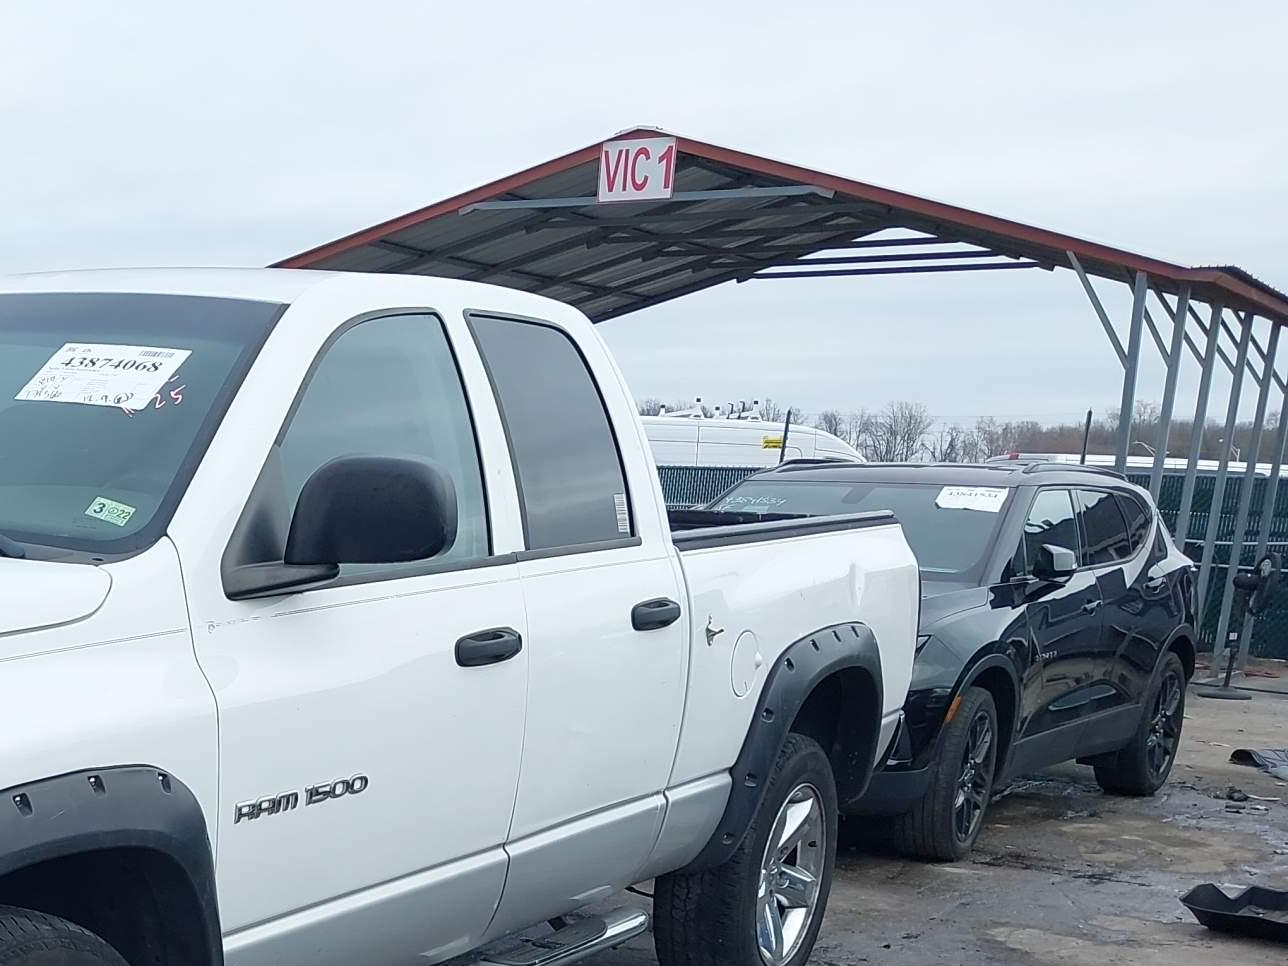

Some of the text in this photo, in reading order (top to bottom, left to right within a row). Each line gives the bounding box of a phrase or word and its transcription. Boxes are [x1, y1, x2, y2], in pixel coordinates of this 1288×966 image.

[604, 145, 673, 193] VIC 1
[61, 356, 162, 373] 43874068
[93, 502, 106, 514] 3
[116, 509, 131, 520] 22
[234, 774, 369, 824] RAM 1500
